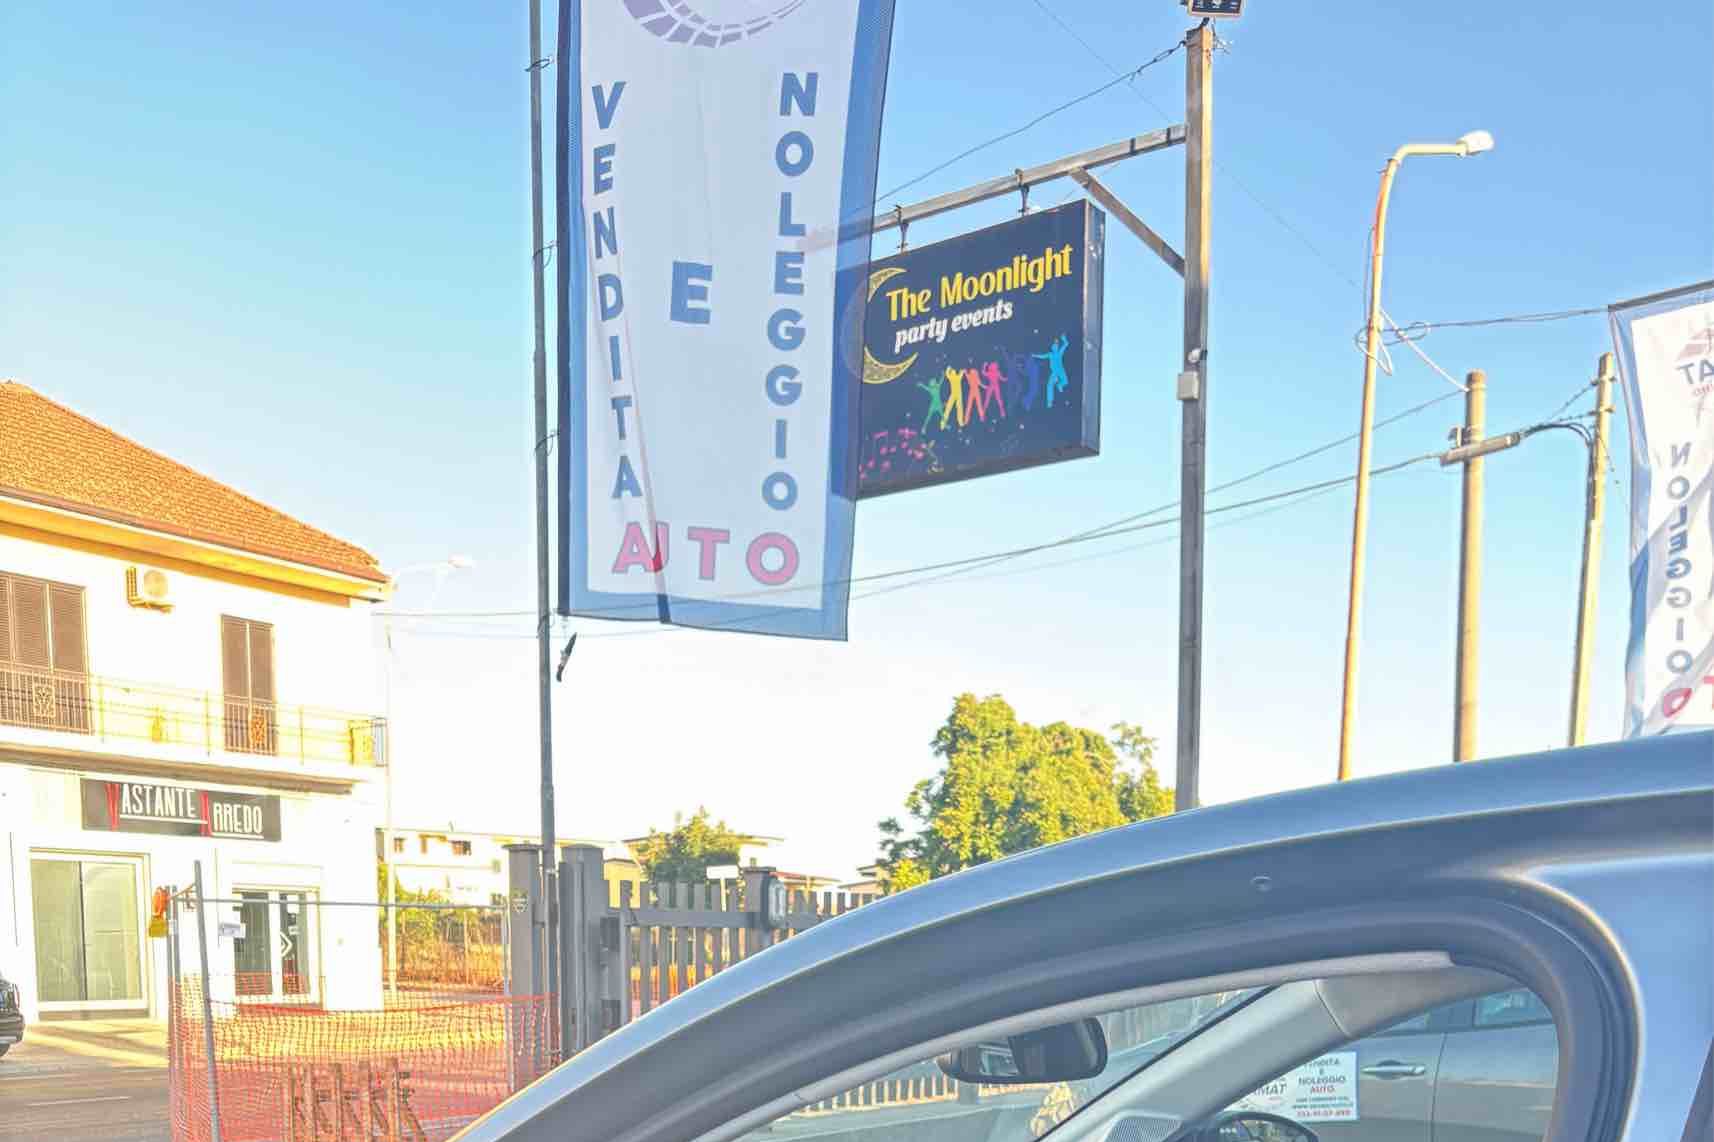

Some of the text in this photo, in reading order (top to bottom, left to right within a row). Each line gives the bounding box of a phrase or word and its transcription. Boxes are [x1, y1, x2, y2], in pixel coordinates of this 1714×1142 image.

[591, 80, 642, 500] VENDITA
[670, 260, 713, 325] E
[762, 71, 818, 512] NOLEGGIO
[886, 243, 1073, 321] The Moonlight
[894, 300, 1013, 353] party events
